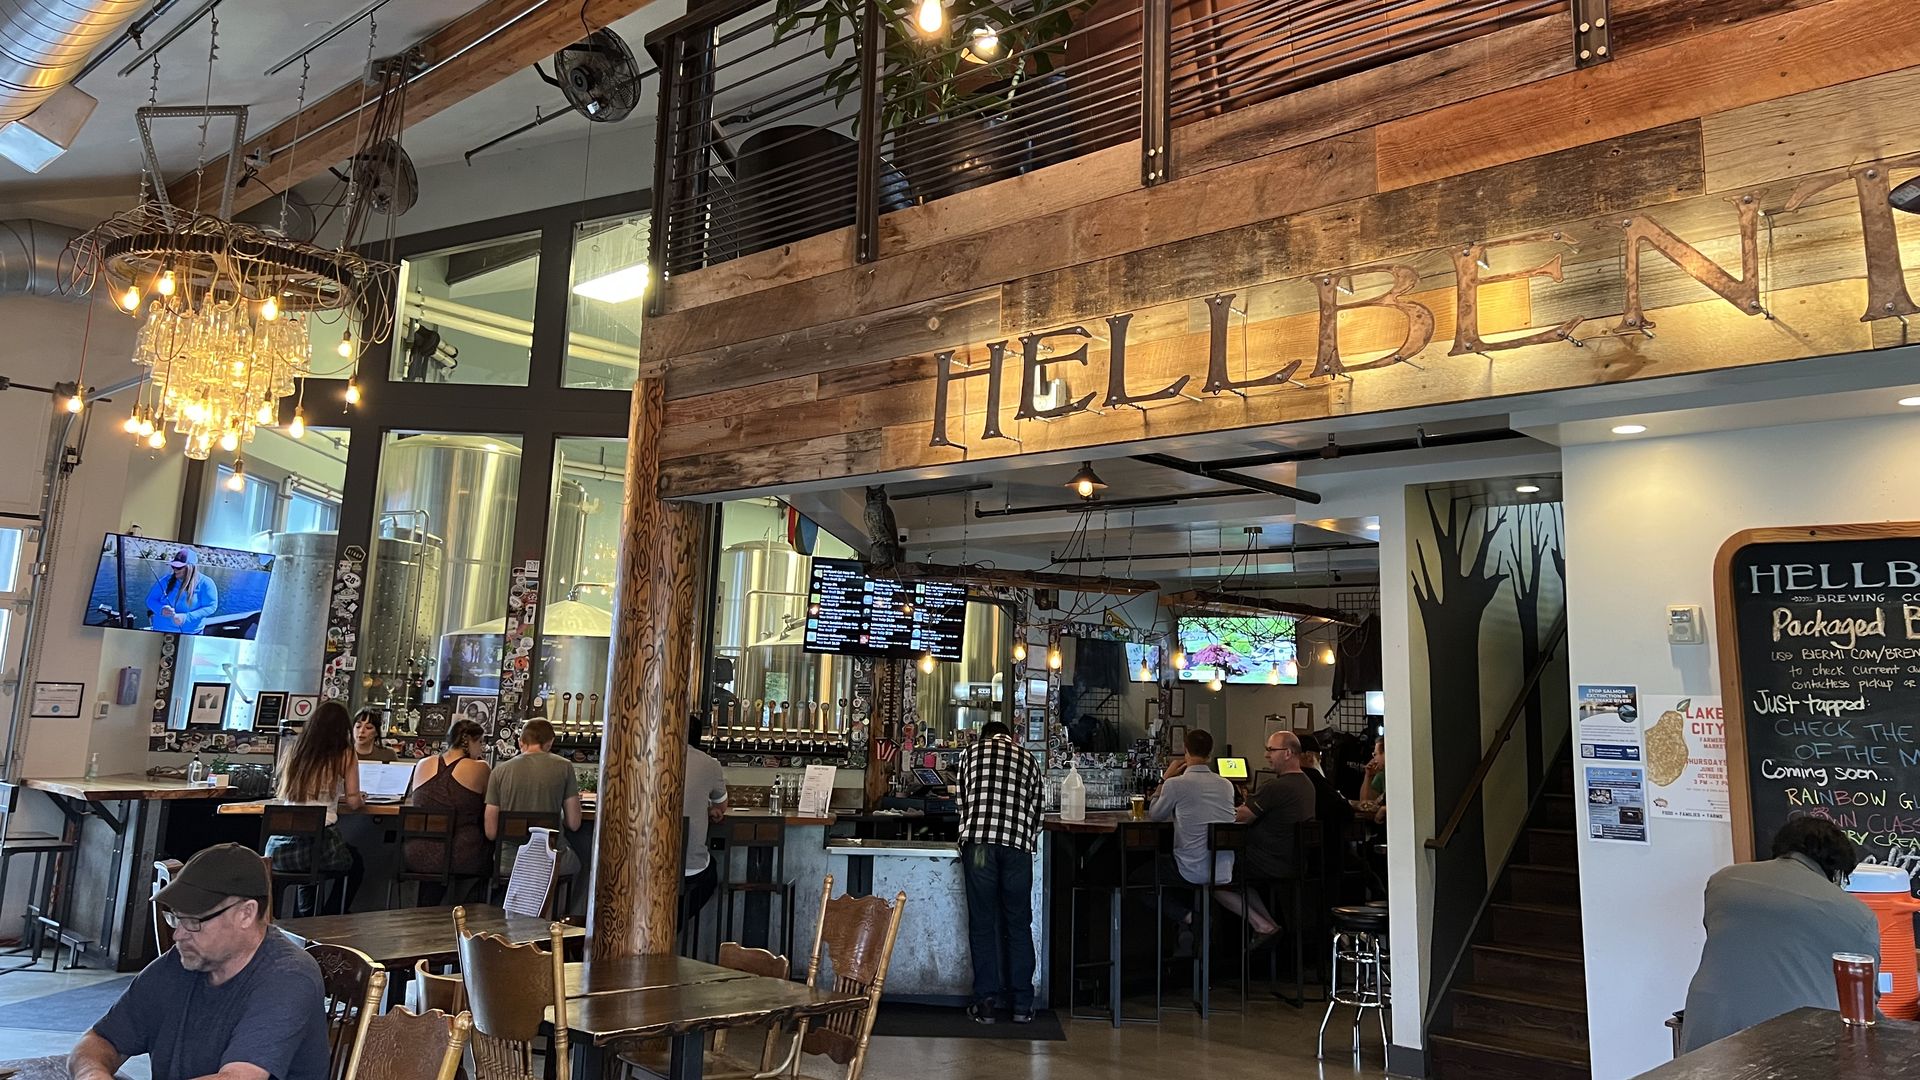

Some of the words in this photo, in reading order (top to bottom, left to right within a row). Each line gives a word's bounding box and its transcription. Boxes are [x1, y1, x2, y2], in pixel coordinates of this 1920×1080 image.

[1749, 560, 1920, 594] HELLB
[1816, 593, 1885, 603] BREWING
[1772, 606, 1886, 649] Packaged
[1789, 665, 1803, 678] to
[1812, 663, 1846, 676] check
[1791, 678, 1850, 690] contactless
[1858, 678, 1894, 693] pickup
[1686, 707, 1724, 719] LAKE
[1801, 693, 1871, 717] tapped:
[1692, 723, 1725, 735] CITY
[1774, 718, 1855, 739] CHECK
[1862, 722, 1914, 743] THE
[1794, 742, 1832, 760] OF
[1837, 745, 1889, 766] THE
[1761, 758, 1829, 787] Coming
[1784, 787, 1886, 807] RAINBOW
[1679, 810, 1701, 818] FAMILIES
